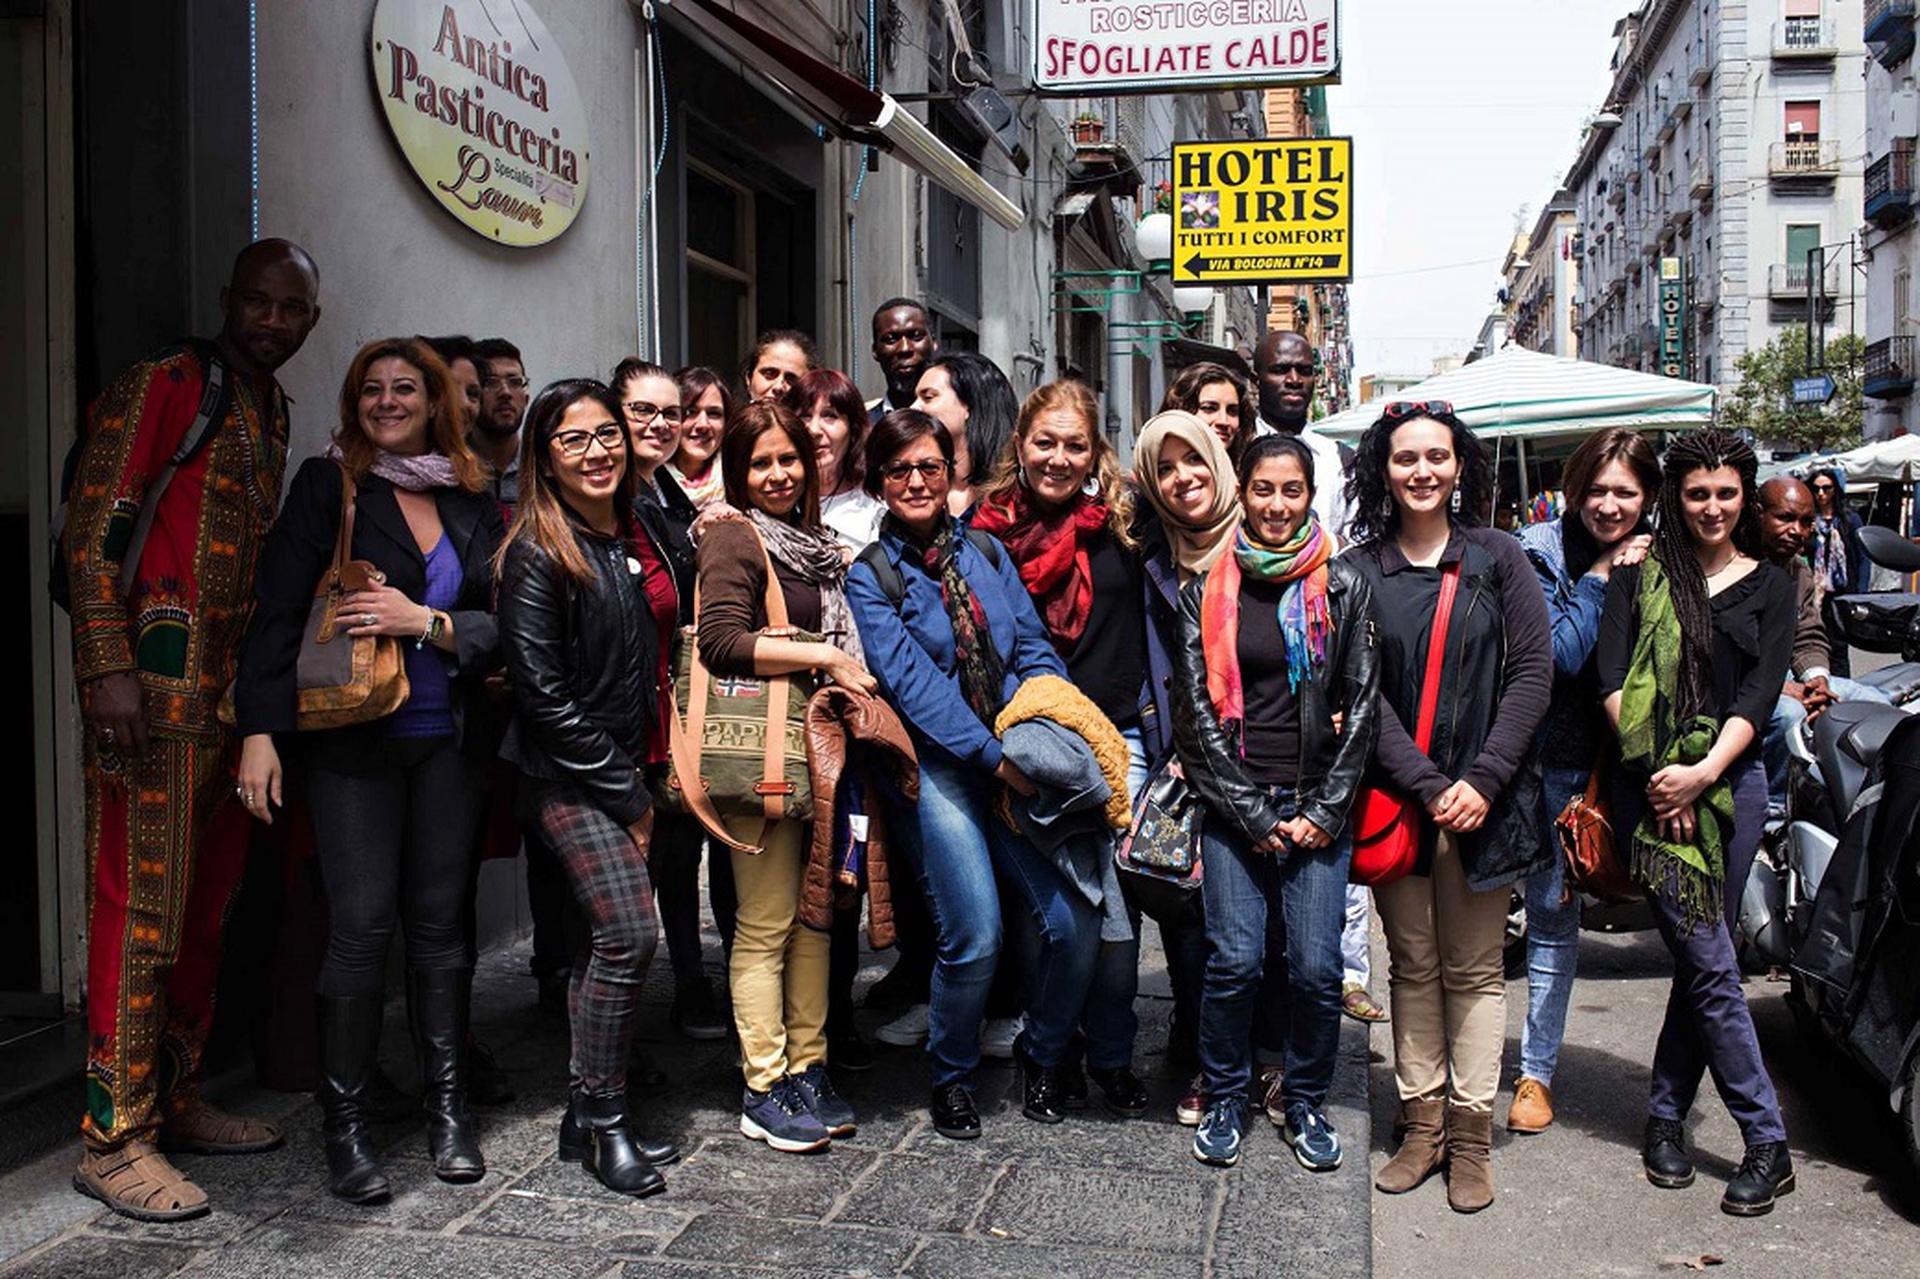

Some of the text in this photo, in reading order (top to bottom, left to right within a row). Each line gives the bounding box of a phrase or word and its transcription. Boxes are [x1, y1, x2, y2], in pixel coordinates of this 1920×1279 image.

[1091, 0, 1308, 33] ROSTICCERIA
[432, 4, 549, 112] Antica
[1046, 22, 1328, 76] SFOGLIATE CALDE
[387, 39, 579, 184] Pasticceria
[1178, 147, 1344, 188] HOTEL
[1234, 188, 1340, 223] IRIS
[1177, 229, 1346, 247] TUTTI I COMFORT
[1208, 258, 1231, 271] VIA
[1233, 257, 1291, 270] BOLOGNA
[1662, 286, 1680, 354] HOTEL
